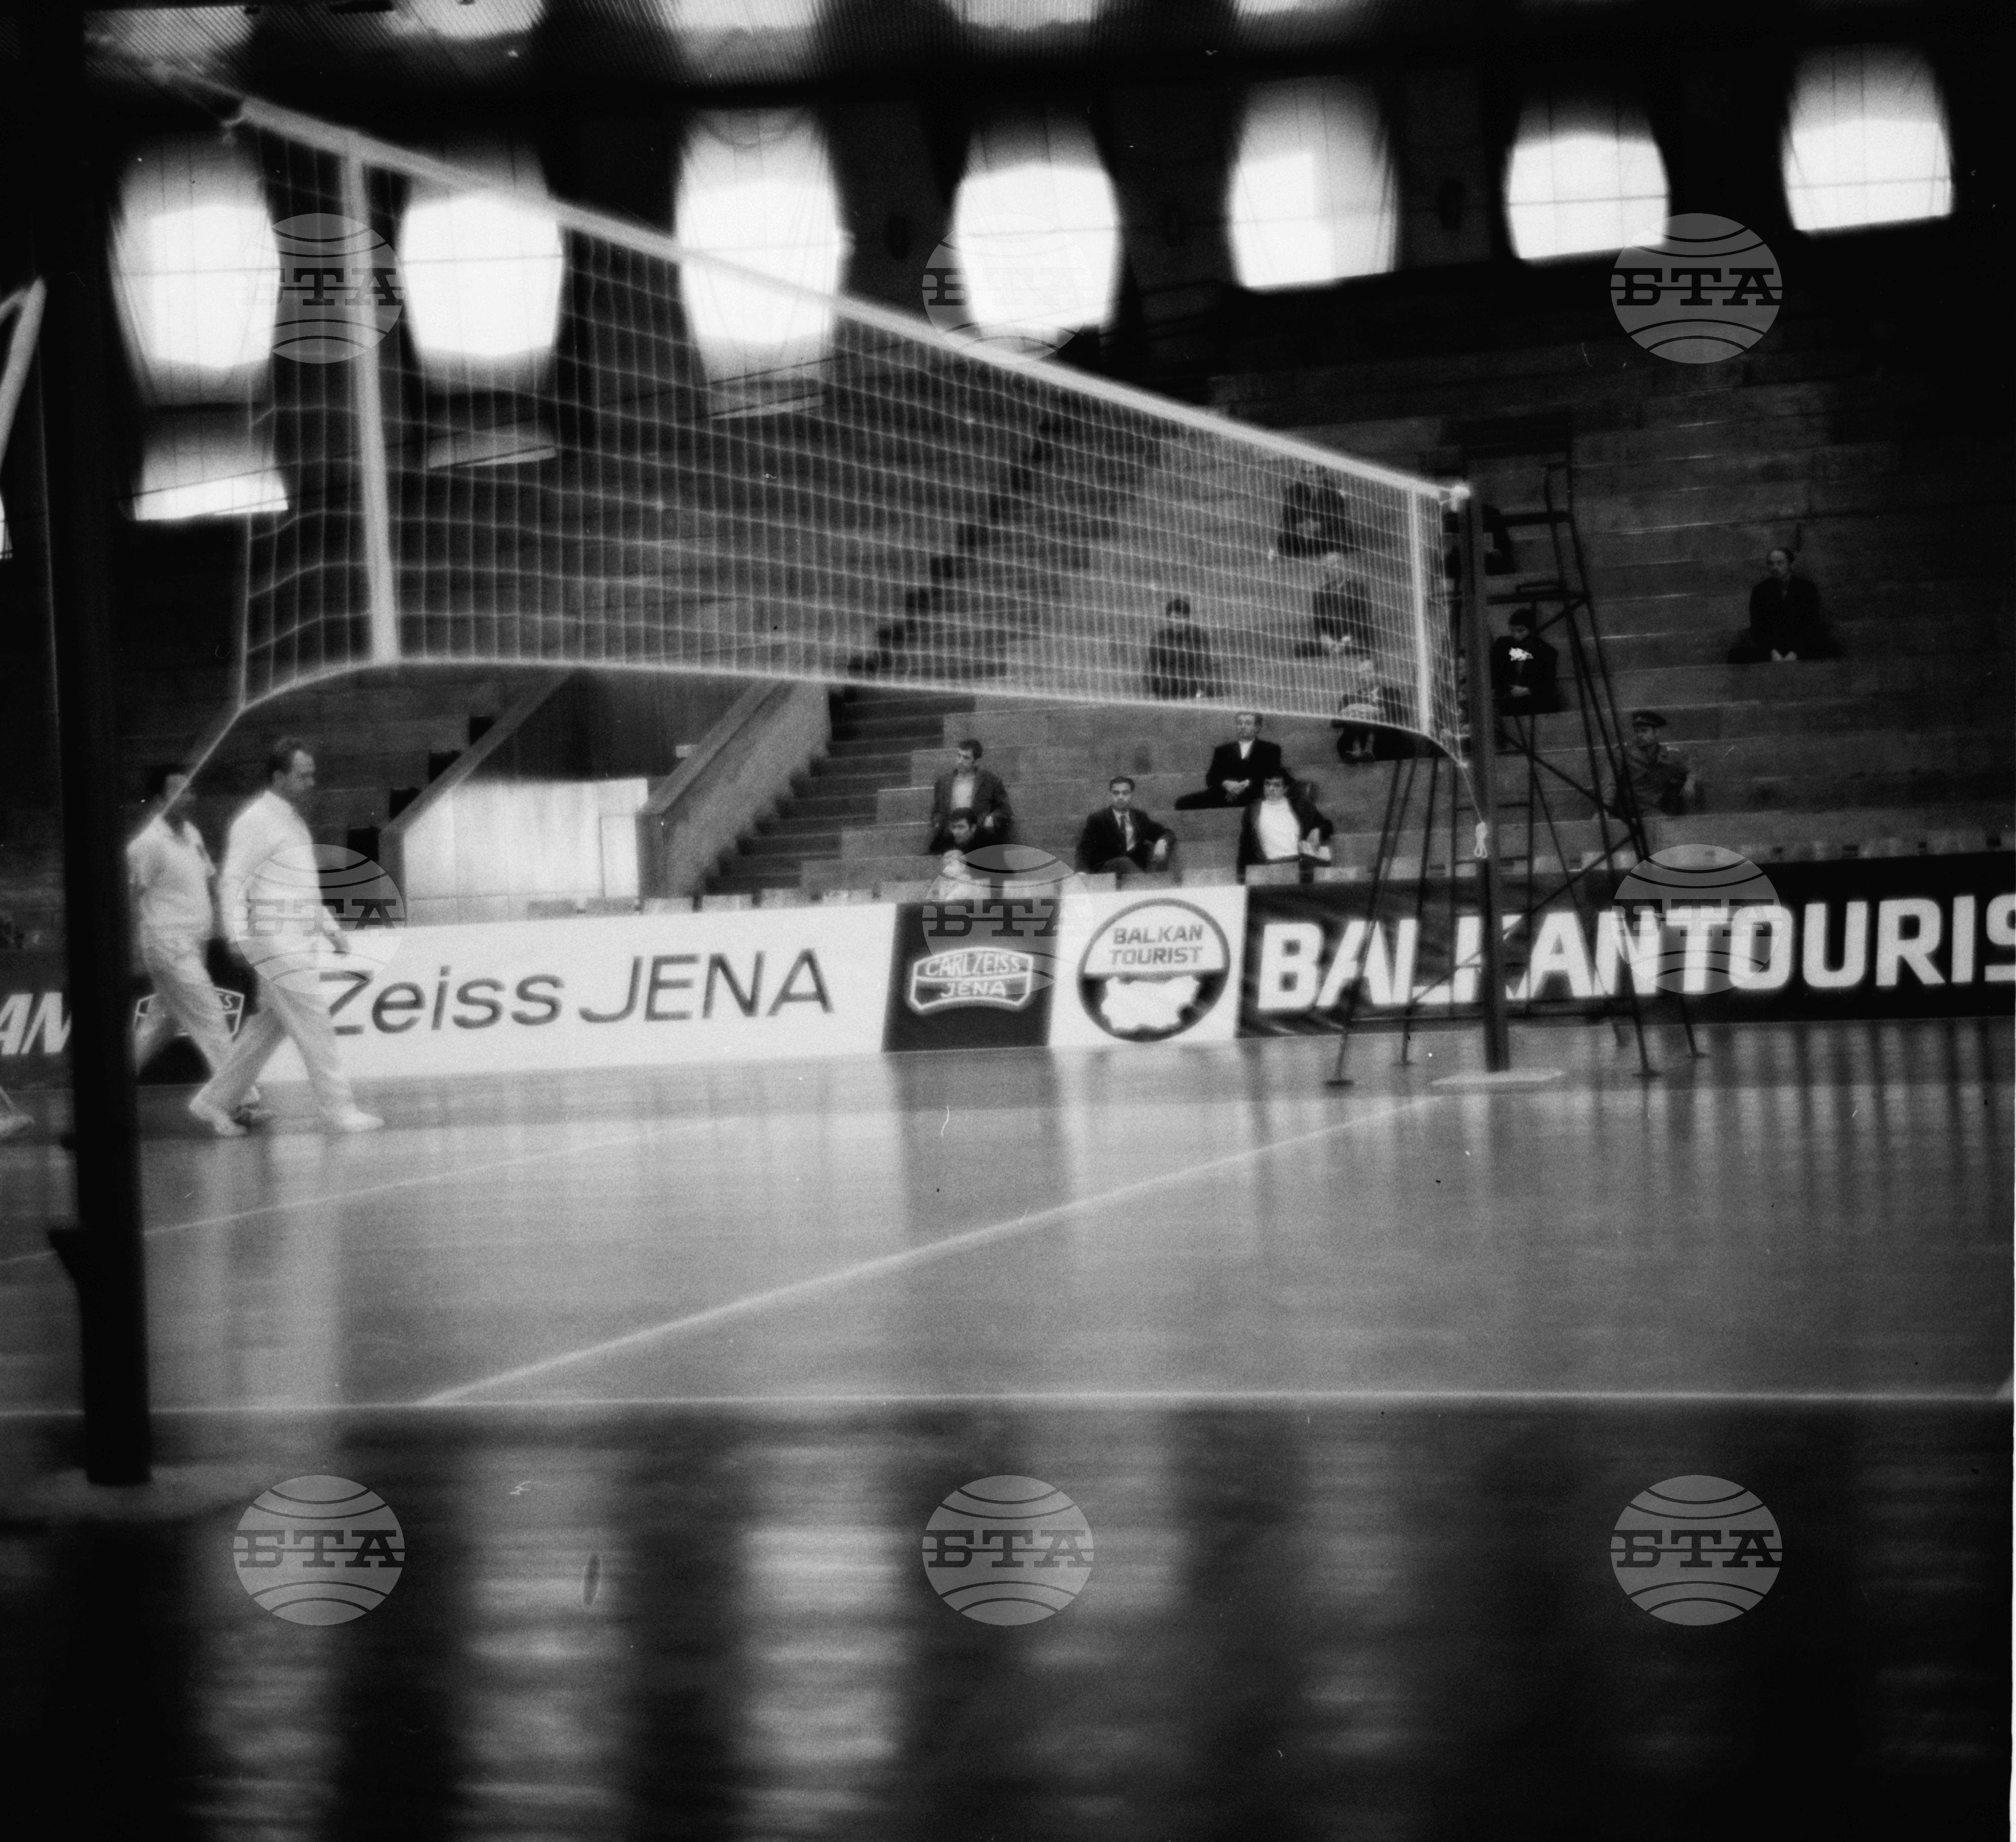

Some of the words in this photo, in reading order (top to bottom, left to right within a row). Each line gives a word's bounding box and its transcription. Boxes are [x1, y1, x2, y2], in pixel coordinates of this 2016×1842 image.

[1113, 924, 1203, 944] BALKAN
[1109, 946, 1203, 965] TOURIST
[319, 966, 564, 1036] Zeiss
[578, 948, 836, 1024] JENA
[940, 981, 1006, 997] JENA
